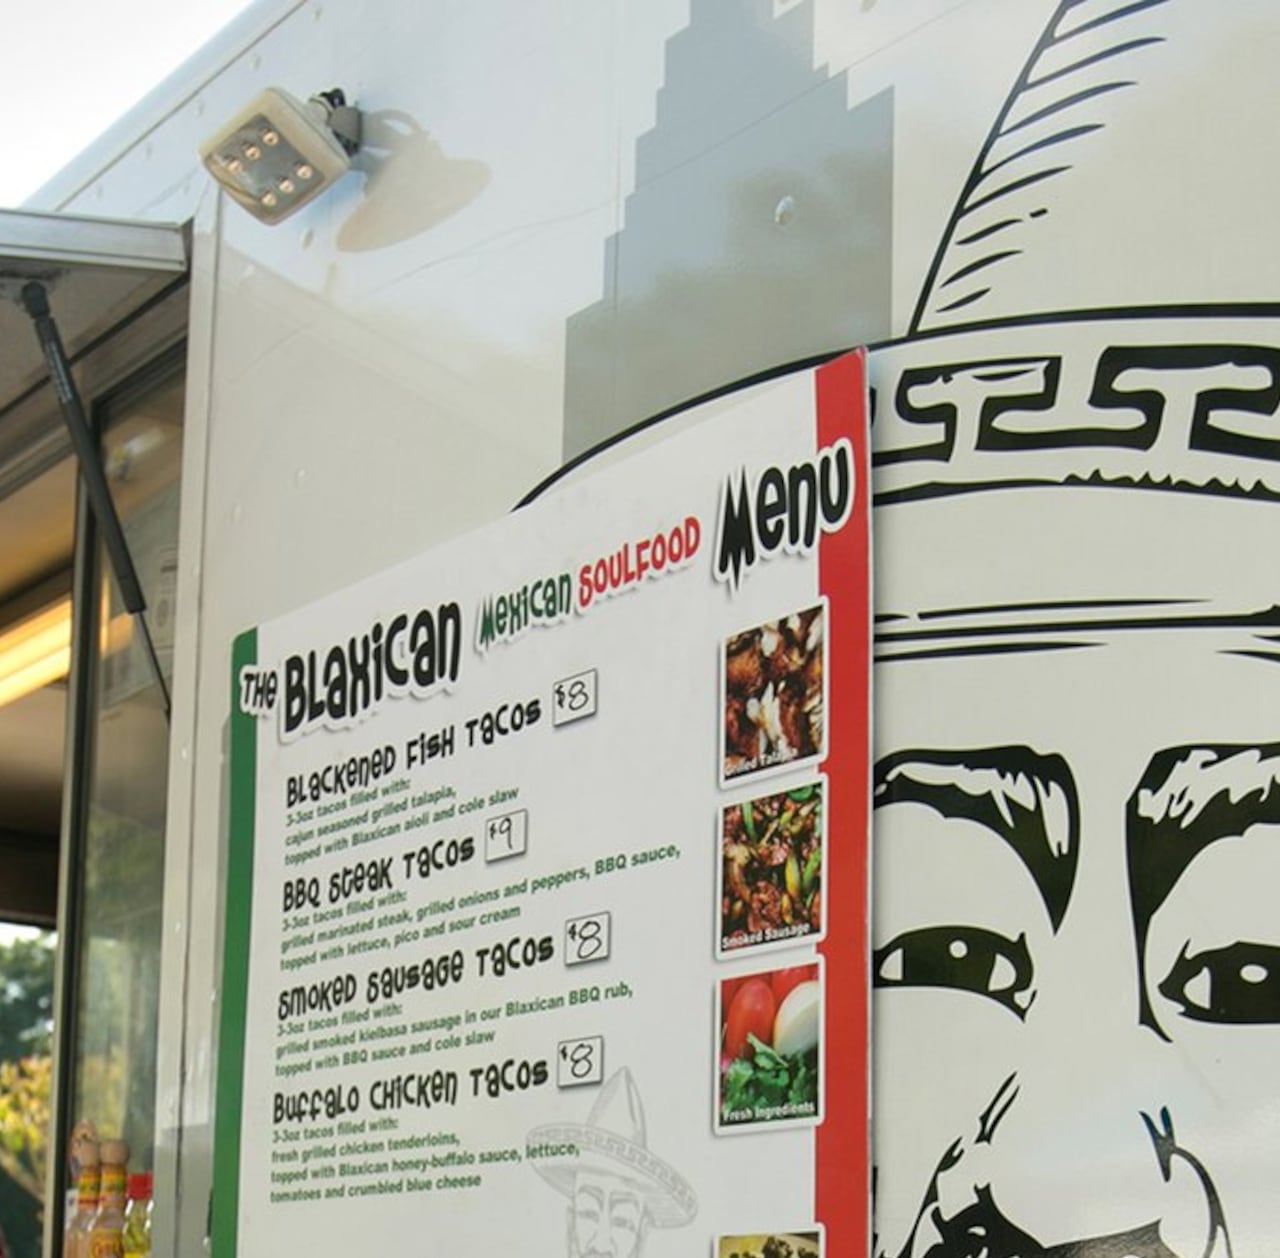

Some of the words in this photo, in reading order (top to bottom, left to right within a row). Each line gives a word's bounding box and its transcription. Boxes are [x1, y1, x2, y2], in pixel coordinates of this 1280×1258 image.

[285, 829, 314, 846] cajun
[316, 809, 369, 837] seasoned
[371, 797, 408, 824] grilled
[316, 799, 347, 817] tacos
[349, 786, 379, 806] filled
[284, 844, 322, 866] topped
[323, 837, 349, 854] with
[351, 823, 401, 846] Blaxican
[432, 803, 456, 823] and
[457, 796, 485, 815] cole
[488, 787, 519, 806] slaw
[281, 931, 315, 954] grilled
[317, 916, 374, 941] marinated
[416, 897, 455, 922] grilled
[458, 888, 500, 909] onions
[503, 878, 528, 898] and
[594, 853, 627, 875] BBQ
[283, 877, 321, 913] BBQ
[280, 951, 317, 971] topped
[319, 945, 344, 961] with
[393, 929, 420, 948] pico
[422, 920, 445, 938] and
[448, 916, 476, 933] sour
[478, 906, 521, 926] cream
[276, 1039, 310, 1060] grilled
[312, 1030, 356, 1050] smoked
[410, 1014, 462, 1034] sausage
[464, 1010, 477, 1024] in
[479, 1007, 502, 1021] our
[505, 996, 565, 1017] Blaxican
[568, 985, 601, 1006] BBQ
[275, 1058, 312, 1078] topped
[315, 1054, 340, 1069] with
[342, 1048, 368, 1066] BBQ
[371, 1045, 406, 1061] sauce
[409, 1038, 432, 1055] and
[434, 1034, 462, 1051] cole
[464, 1030, 495, 1046] slaw
[270, 1167, 308, 1184] topped
[310, 1165, 336, 1179] with
[338, 1162, 389, 1177] Blaxican
[271, 1149, 299, 1163] fresh
[301, 1144, 336, 1164] grilled
[338, 1140, 385, 1156] chicken
[270, 1188, 321, 1203] tomatoes
[324, 1184, 345, 1198] and
[347, 1178, 403, 1197] crumbled
[406, 1177, 433, 1192] blue
[435, 1174, 482, 1190] cheese
